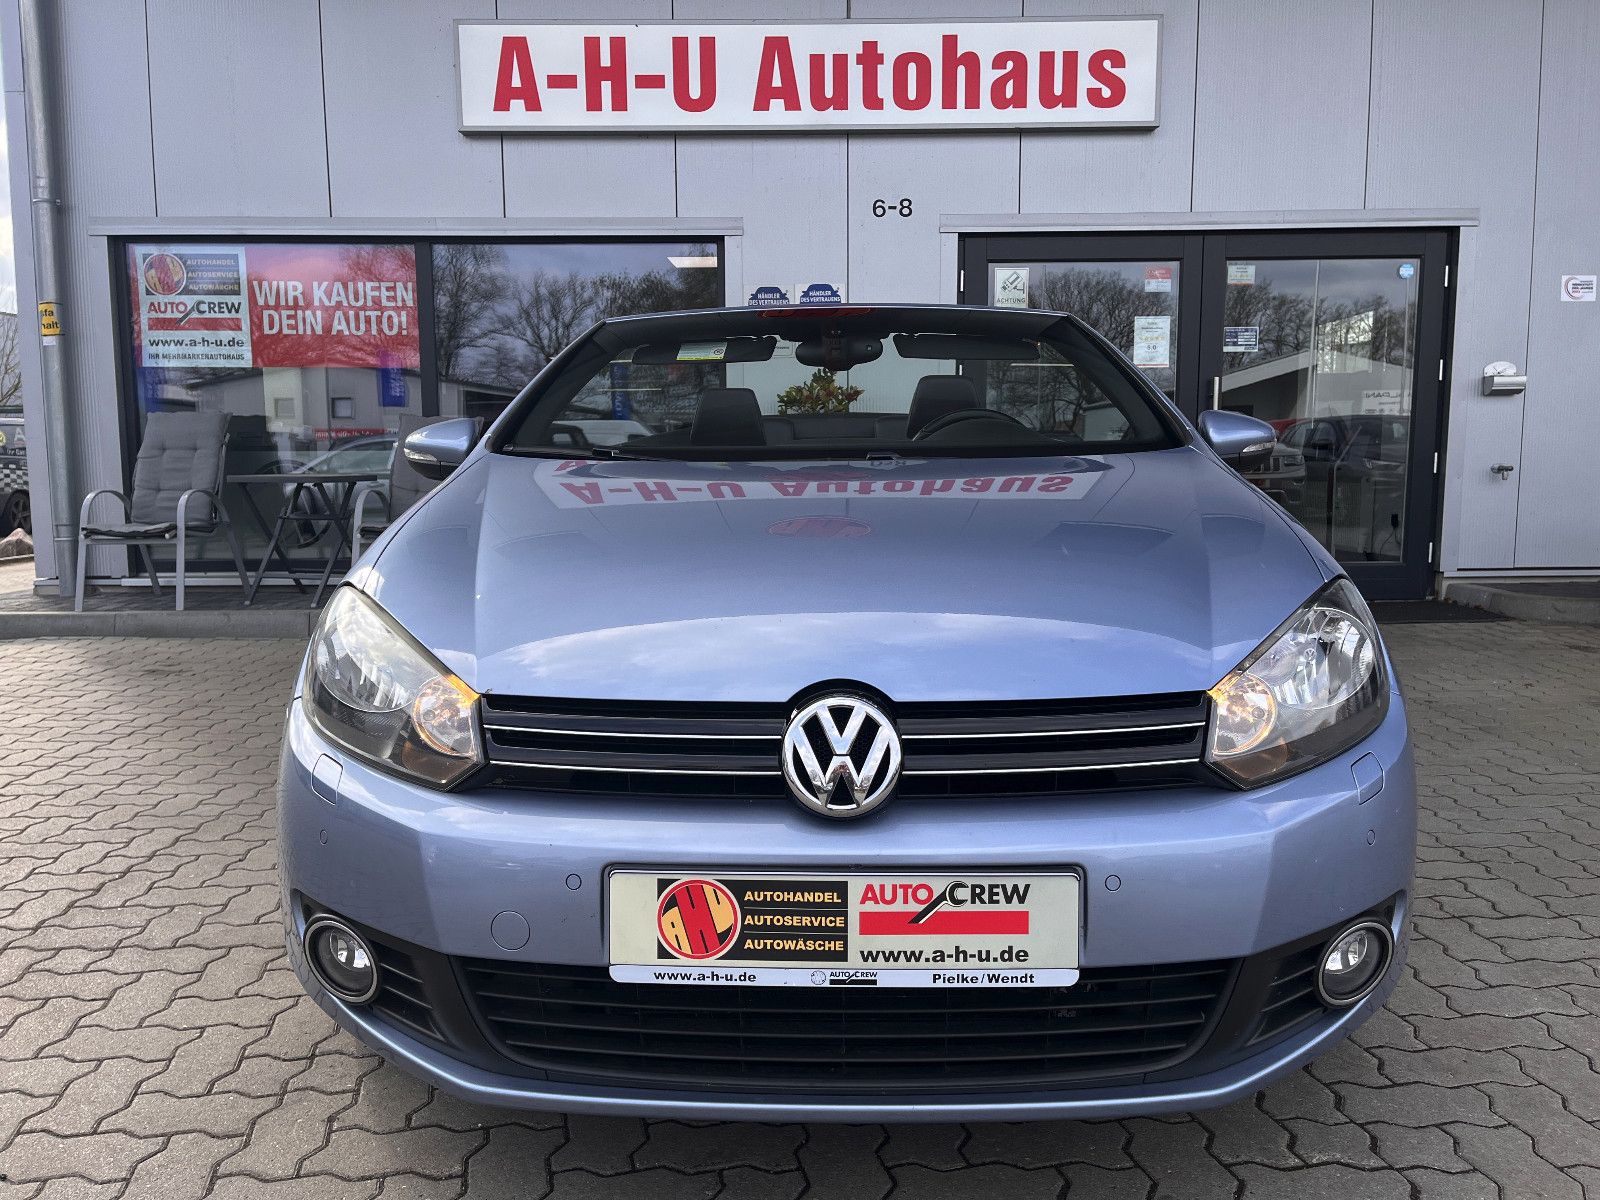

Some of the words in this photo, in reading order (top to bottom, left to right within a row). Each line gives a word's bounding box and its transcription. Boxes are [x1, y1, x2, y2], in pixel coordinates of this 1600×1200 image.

[493, 36, 716, 112] A-H-U
[753, 34, 1127, 112] Autohaus
[872, 198, 913, 218] 6-8
[252, 280, 305, 306] WIR
[312, 281, 414, 307] KAUFEN
[262, 310, 323, 335] DEIN
[330, 310, 408, 336] AUTO!
[148, 337, 245, 347] www.a-h-u.de
[744, 891, 842, 903] AUTOHANDEL
[859, 883, 934, 905] AUTO
[946, 881, 1031, 907] CREW
[744, 915, 845, 927] AUTOSERVICE
[744, 938, 845, 951] AUTOWÄSCHE
[859, 946, 1029, 963] www.a-h-u.de
[653, 971, 757, 983] www.a-h-u.de
[932, 972, 1035, 984] Pielke/Wendt
